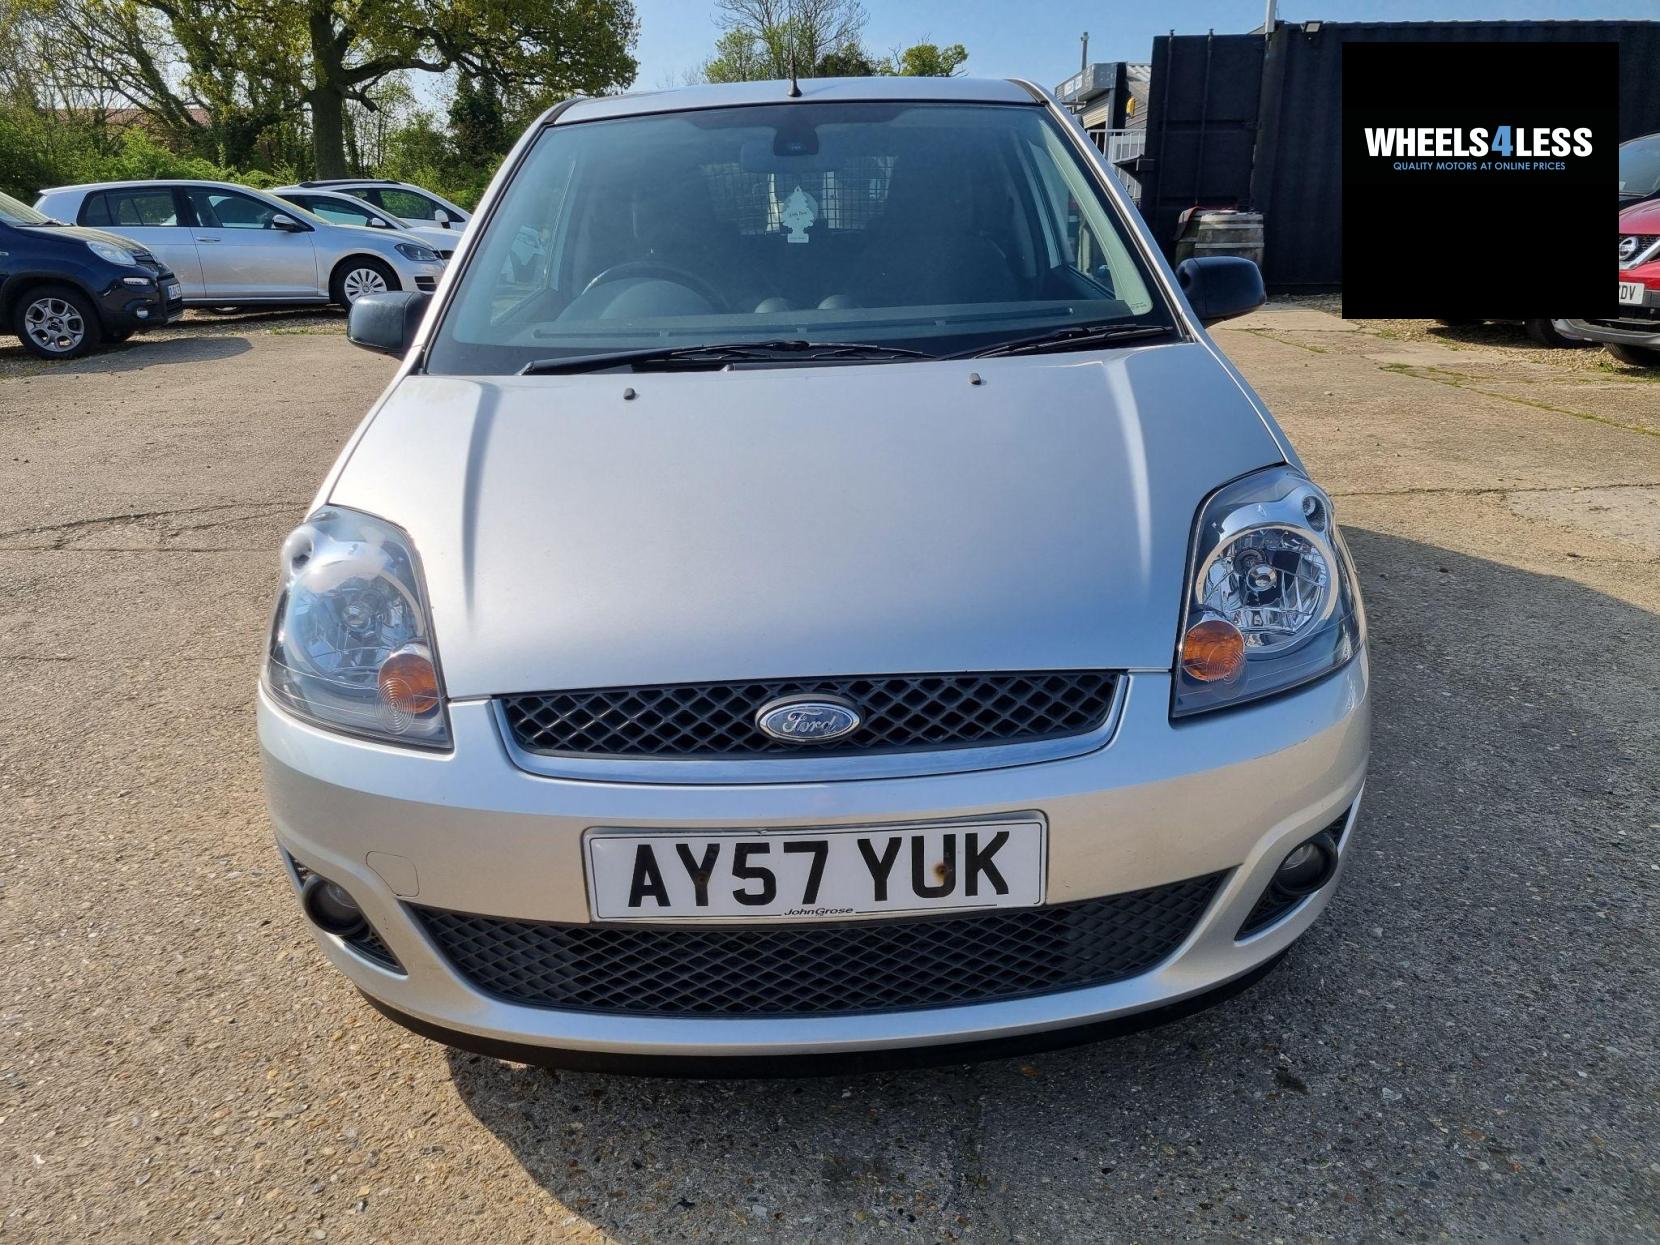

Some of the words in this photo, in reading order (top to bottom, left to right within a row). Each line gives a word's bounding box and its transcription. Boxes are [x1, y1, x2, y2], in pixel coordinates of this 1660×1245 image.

[1619, 284, 1636, 301] DV
[782, 710, 838, 733] Ford
[627, 839, 829, 908] AY57
[857, 830, 1010, 902] YUK
